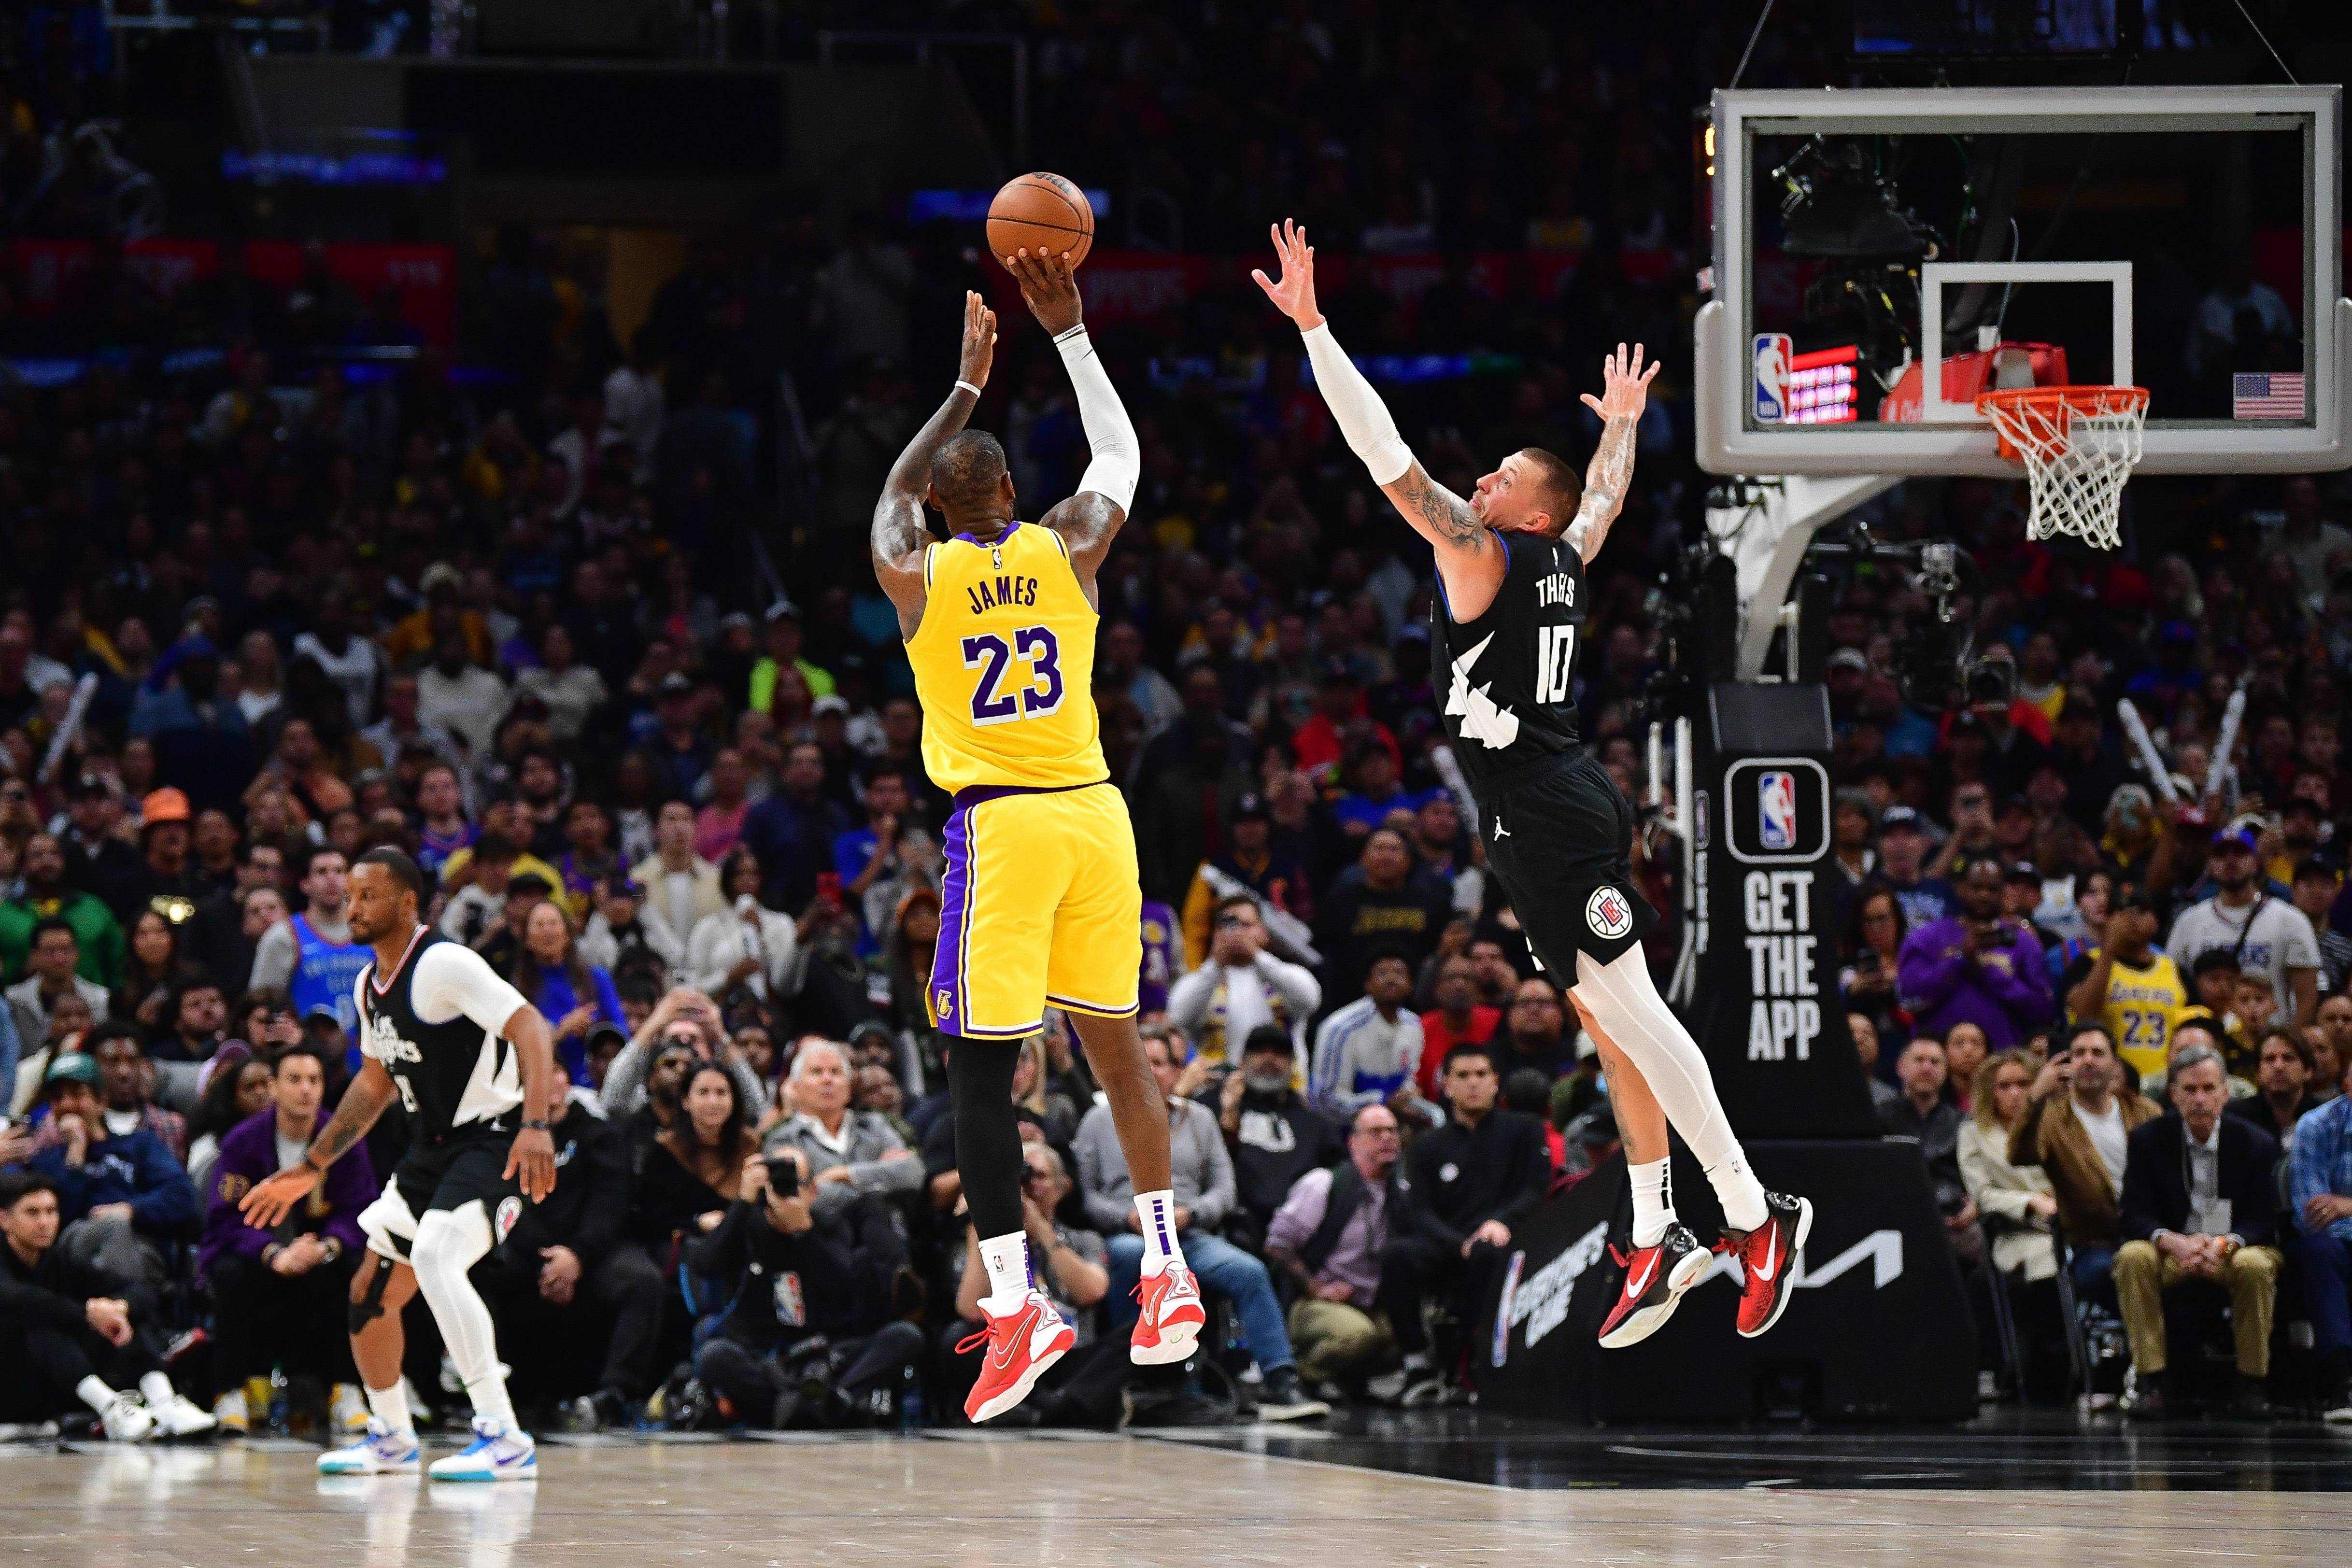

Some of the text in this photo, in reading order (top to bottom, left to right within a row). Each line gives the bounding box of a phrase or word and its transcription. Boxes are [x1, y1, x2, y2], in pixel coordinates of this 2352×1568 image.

[967, 576, 1037, 614] JAMES
[959, 624, 1066, 727] 23
[1535, 624, 1574, 704] 10
[1744, 870, 1814, 932] GET
[1744, 935, 1818, 997] THE
[1747, 999, 1821, 1060] APP
[2123, 1009, 2166, 1048] 23
